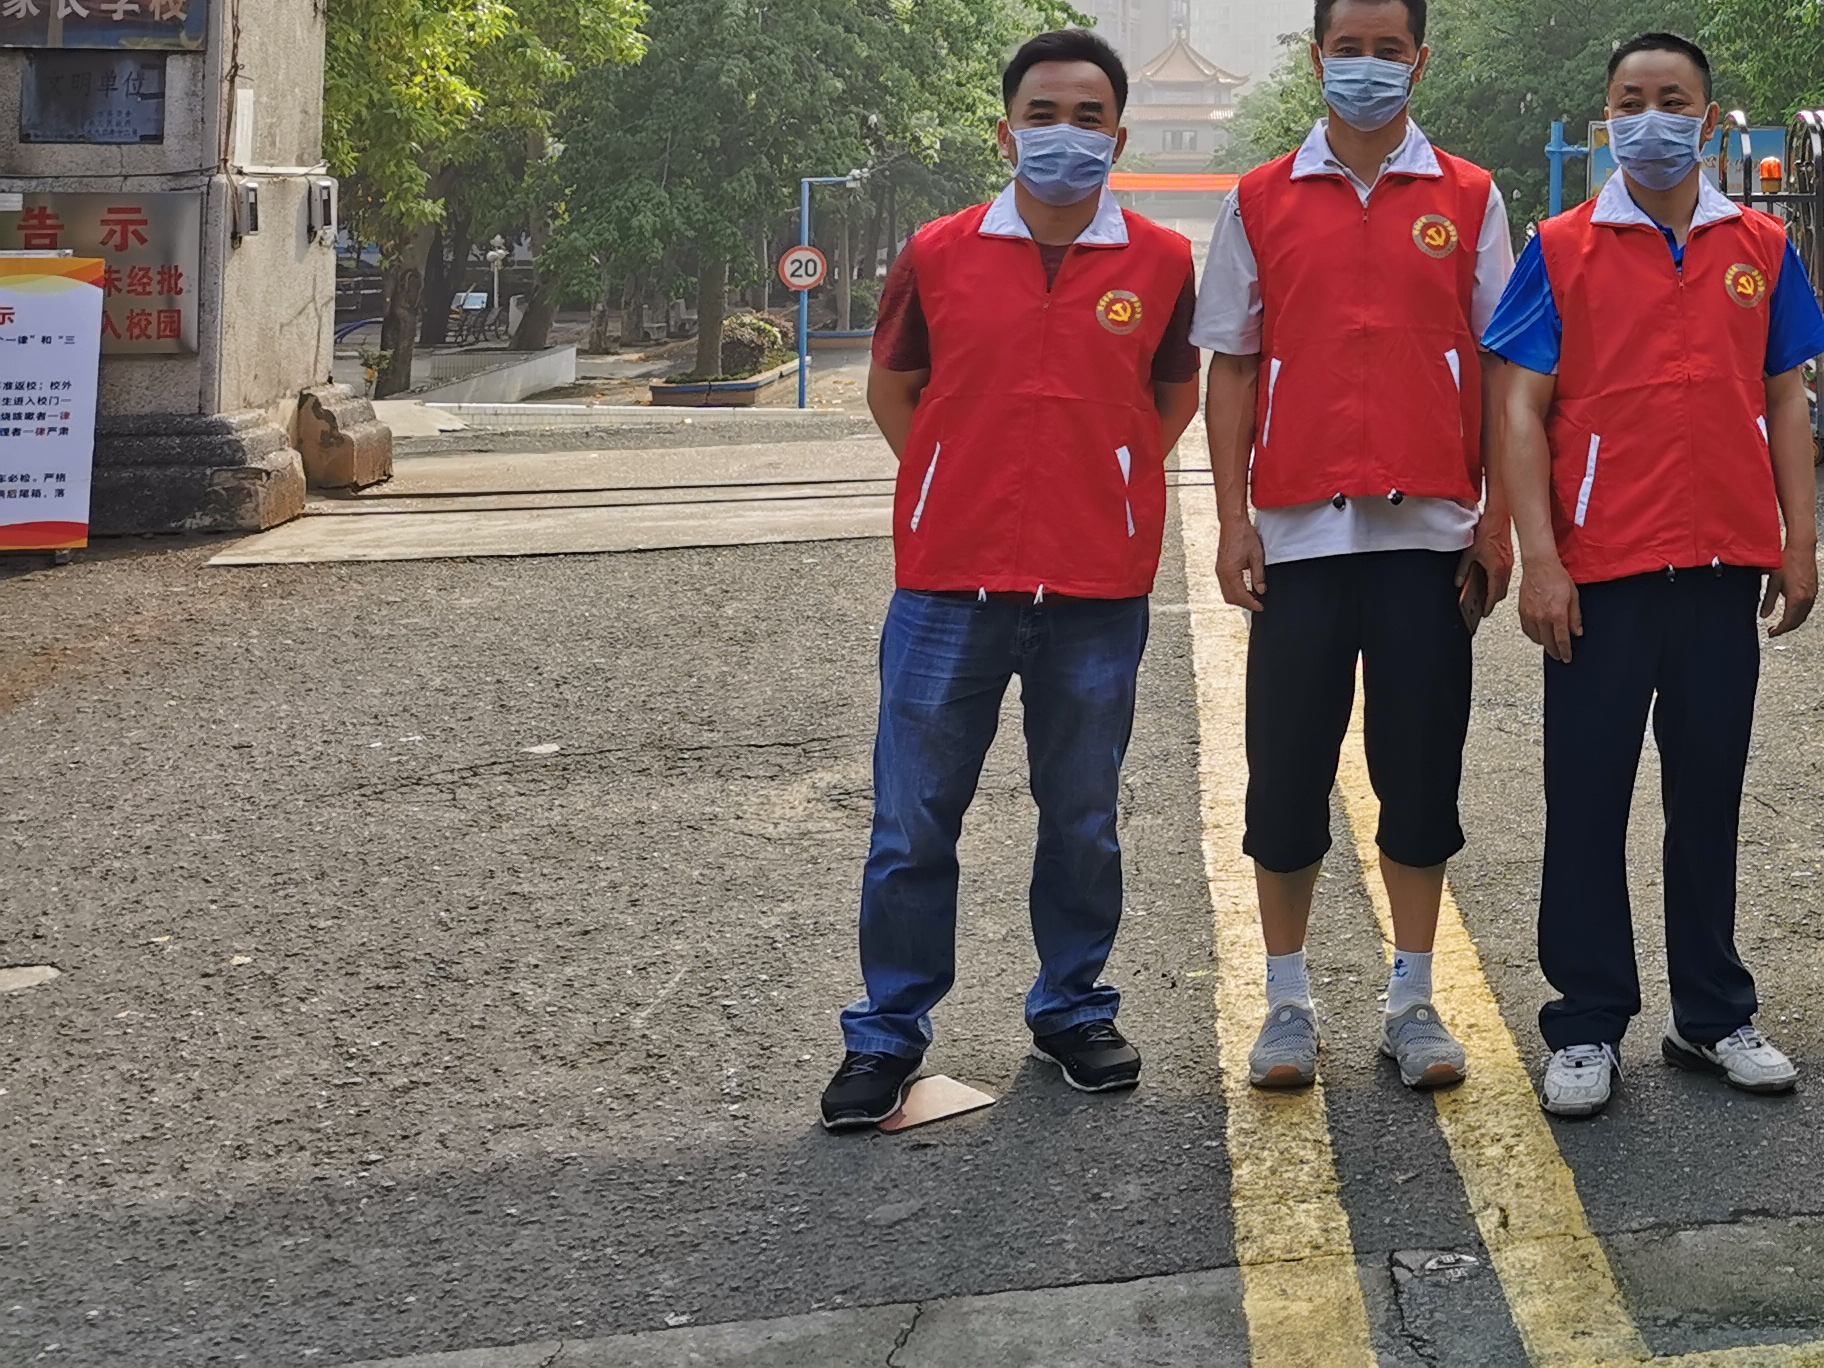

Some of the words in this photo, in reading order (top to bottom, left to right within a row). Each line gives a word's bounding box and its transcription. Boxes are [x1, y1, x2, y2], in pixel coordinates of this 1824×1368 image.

[44, 66, 145, 99] 文明单位
[16, 206, 148, 252] 告示
[789, 258, 819, 279] 20
